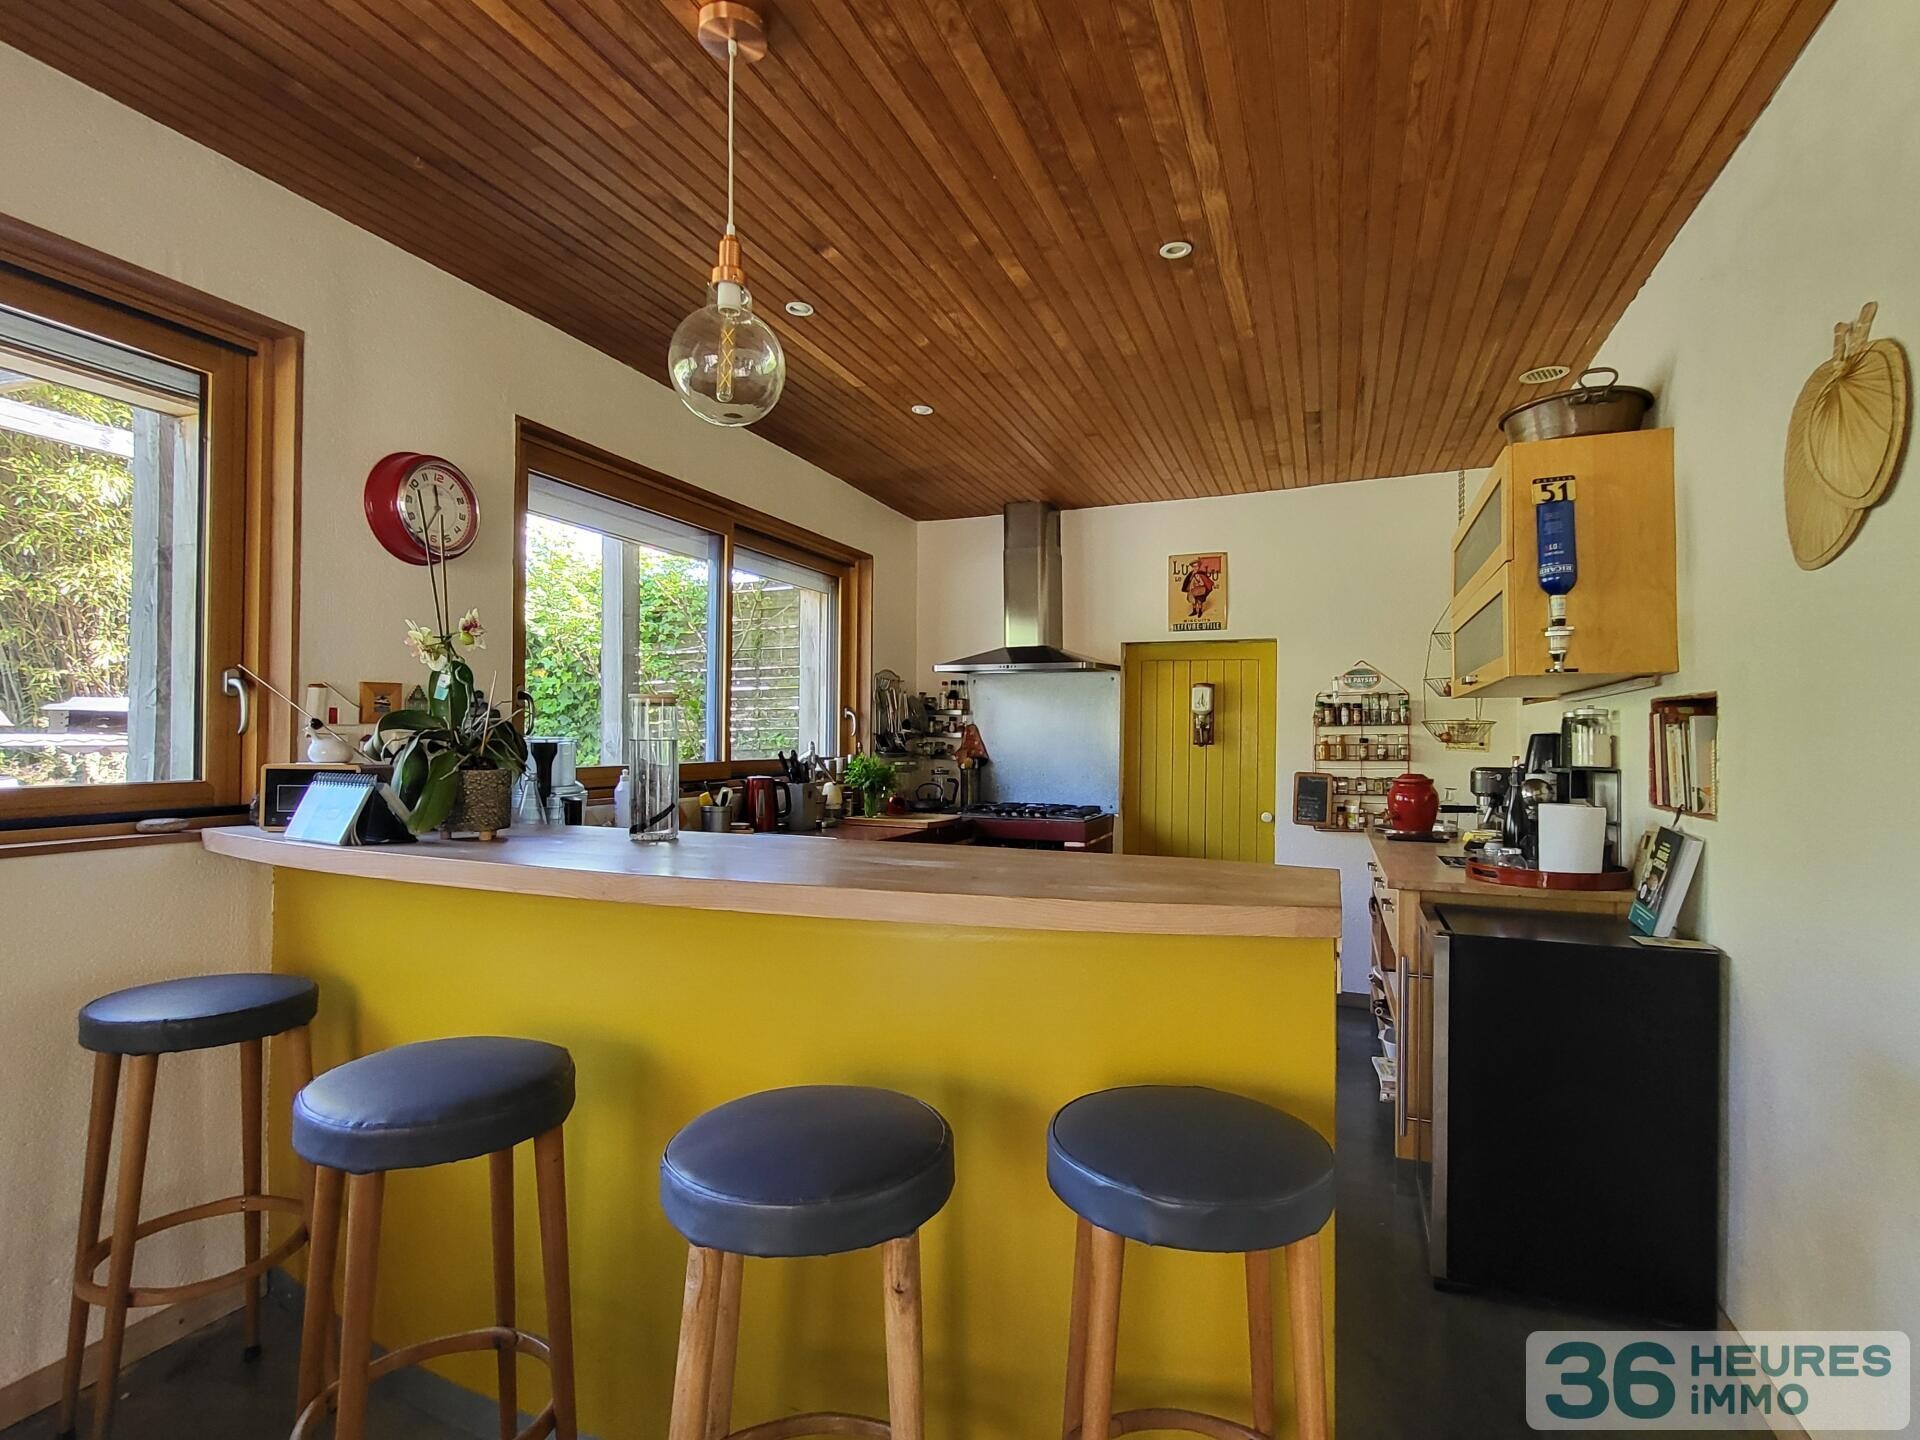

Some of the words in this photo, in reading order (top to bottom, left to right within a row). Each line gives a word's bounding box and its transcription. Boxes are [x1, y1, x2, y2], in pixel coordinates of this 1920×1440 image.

[422, 473, 428, 482] 11
[434, 473, 444, 483] 12
[409, 478, 419, 490] 10
[1541, 482, 1568, 502] 51
[405, 495, 412, 504] 9
[457, 497, 464, 505] 2
[408, 512, 415, 521] 8
[459, 513, 466, 521] 3
[455, 526, 461, 534] 4
[430, 535, 437, 543] 6
[444, 535, 451, 543] 5
